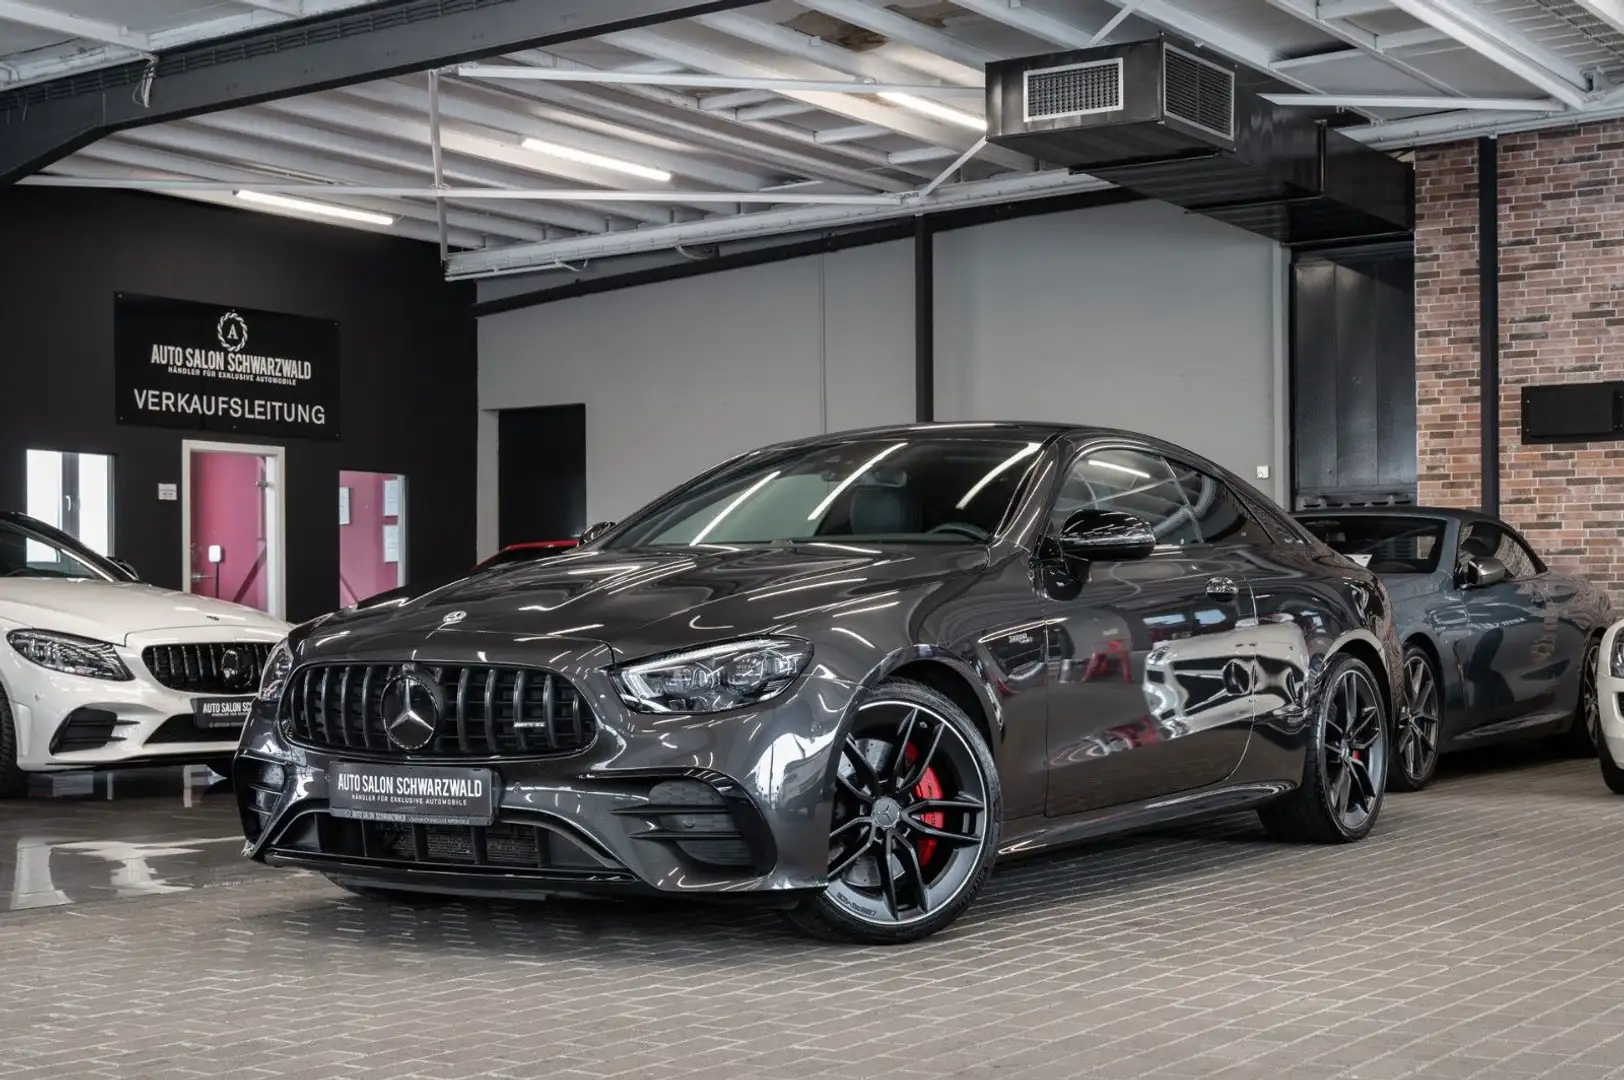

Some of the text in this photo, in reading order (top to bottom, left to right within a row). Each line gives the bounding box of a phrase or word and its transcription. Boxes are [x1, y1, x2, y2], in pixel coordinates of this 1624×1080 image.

[227, 324, 238, 340] A
[151, 344, 312, 380] AUTO SALON SCHWARZWALD
[168, 366, 297, 386] HÄNDLER FÜR EXKLUSIVE AUTOMOBILE
[133, 388, 325, 424] VERKAUFSLEITUNG
[203, 702, 220, 714] AUTO
[221, 701, 241, 713] SALON
[337, 773, 482, 797] AUTO SALON SCHWARZWALD
[352, 793, 467, 806] HÄNDLER FÜR EXKLUSIVE AUTOMOBILE
